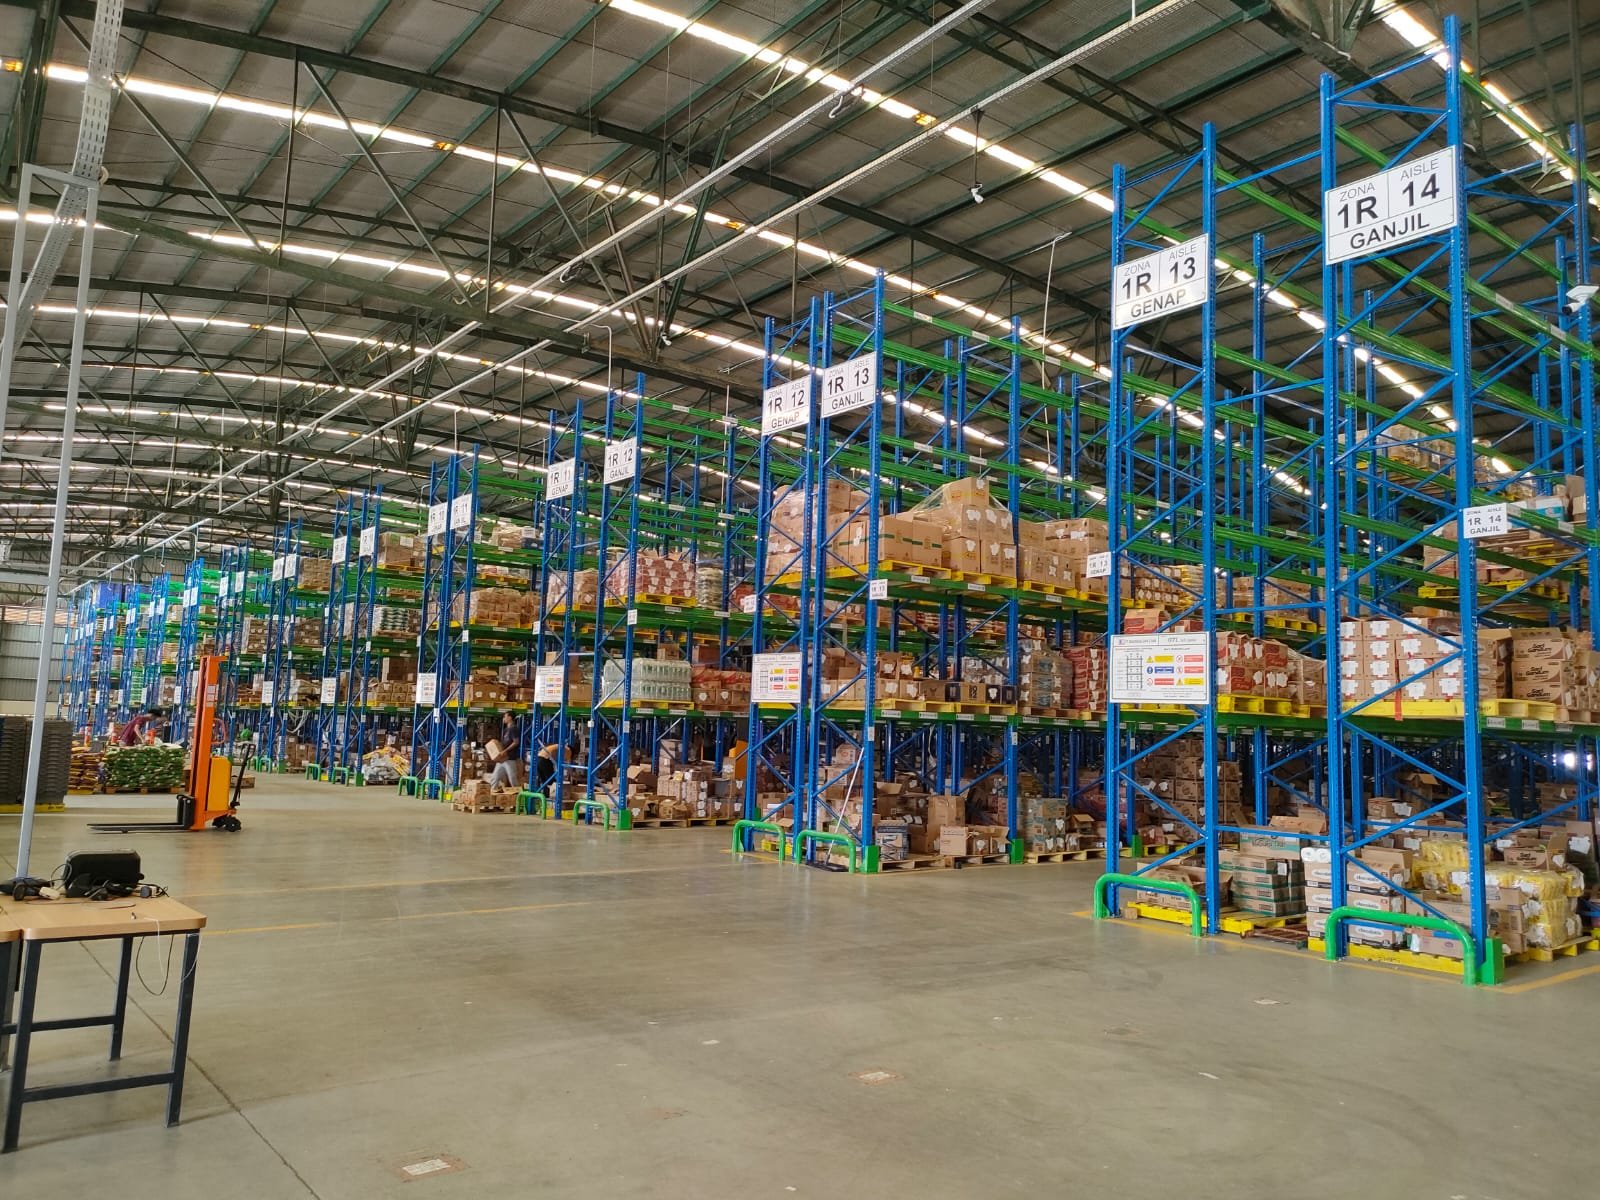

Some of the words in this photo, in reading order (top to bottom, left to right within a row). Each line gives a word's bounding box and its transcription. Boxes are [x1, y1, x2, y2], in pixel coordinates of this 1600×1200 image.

[1340, 183, 1376, 202] ZONA
[1400, 158, 1439, 181] AISLE
[1337, 196, 1378, 229] 1R
[1402, 173, 1440, 206] 14
[1350, 213, 1429, 249] GANJIL
[1124, 260, 1151, 276] ZONA
[1169, 244, 1197, 261] AISLE
[1122, 272, 1152, 299] 1R
[1169, 257, 1196, 284] 13
[1131, 289, 1186, 318] GENAP
[854, 359, 870, 368] AISLE
[827, 376, 844, 395] 1R
[854, 368, 869, 387] 13
[768, 397, 782, 414] 1R
[792, 390, 805, 408] 12
[832, 391, 864, 409] GANJIL
[771, 411, 799, 428] GENAP
[608, 453, 618, 467] 1R
[624, 448, 633, 462] 12
[550, 472, 560, 484] 1R
[610, 467, 629, 479] GANJIL
[552, 485, 568, 495] GENAP
[1467, 518, 1482, 526] 1R
[1489, 515, 1502, 523] 14
[1470, 526, 1500, 534] GANJIL
